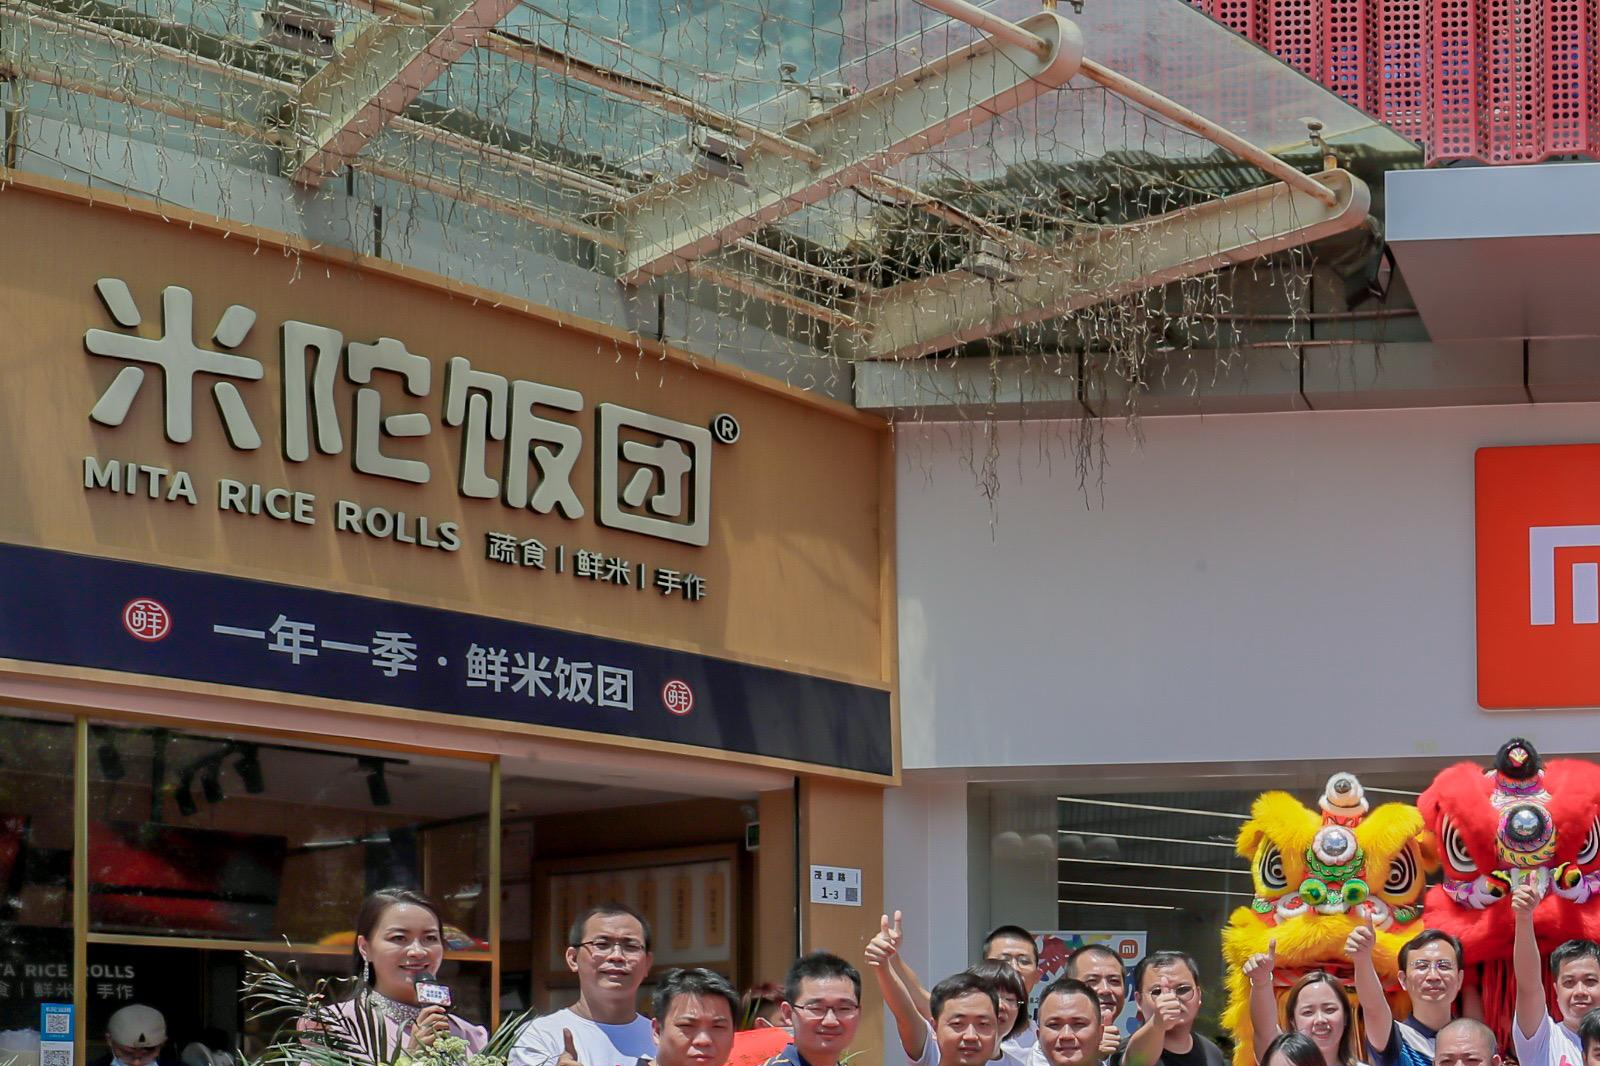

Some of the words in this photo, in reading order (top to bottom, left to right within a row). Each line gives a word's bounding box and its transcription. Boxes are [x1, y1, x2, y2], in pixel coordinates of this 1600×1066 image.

[84, 277, 713, 548] 米陀饭团
[83, 456, 198, 505] MITA
[217, 478, 316, 526] RICE
[335, 500, 462, 552] ROLLS
[821, 887, 839, 899] 1-3
[25, 964, 68, 977] RICE
[86, 964, 135, 978] OLLS
